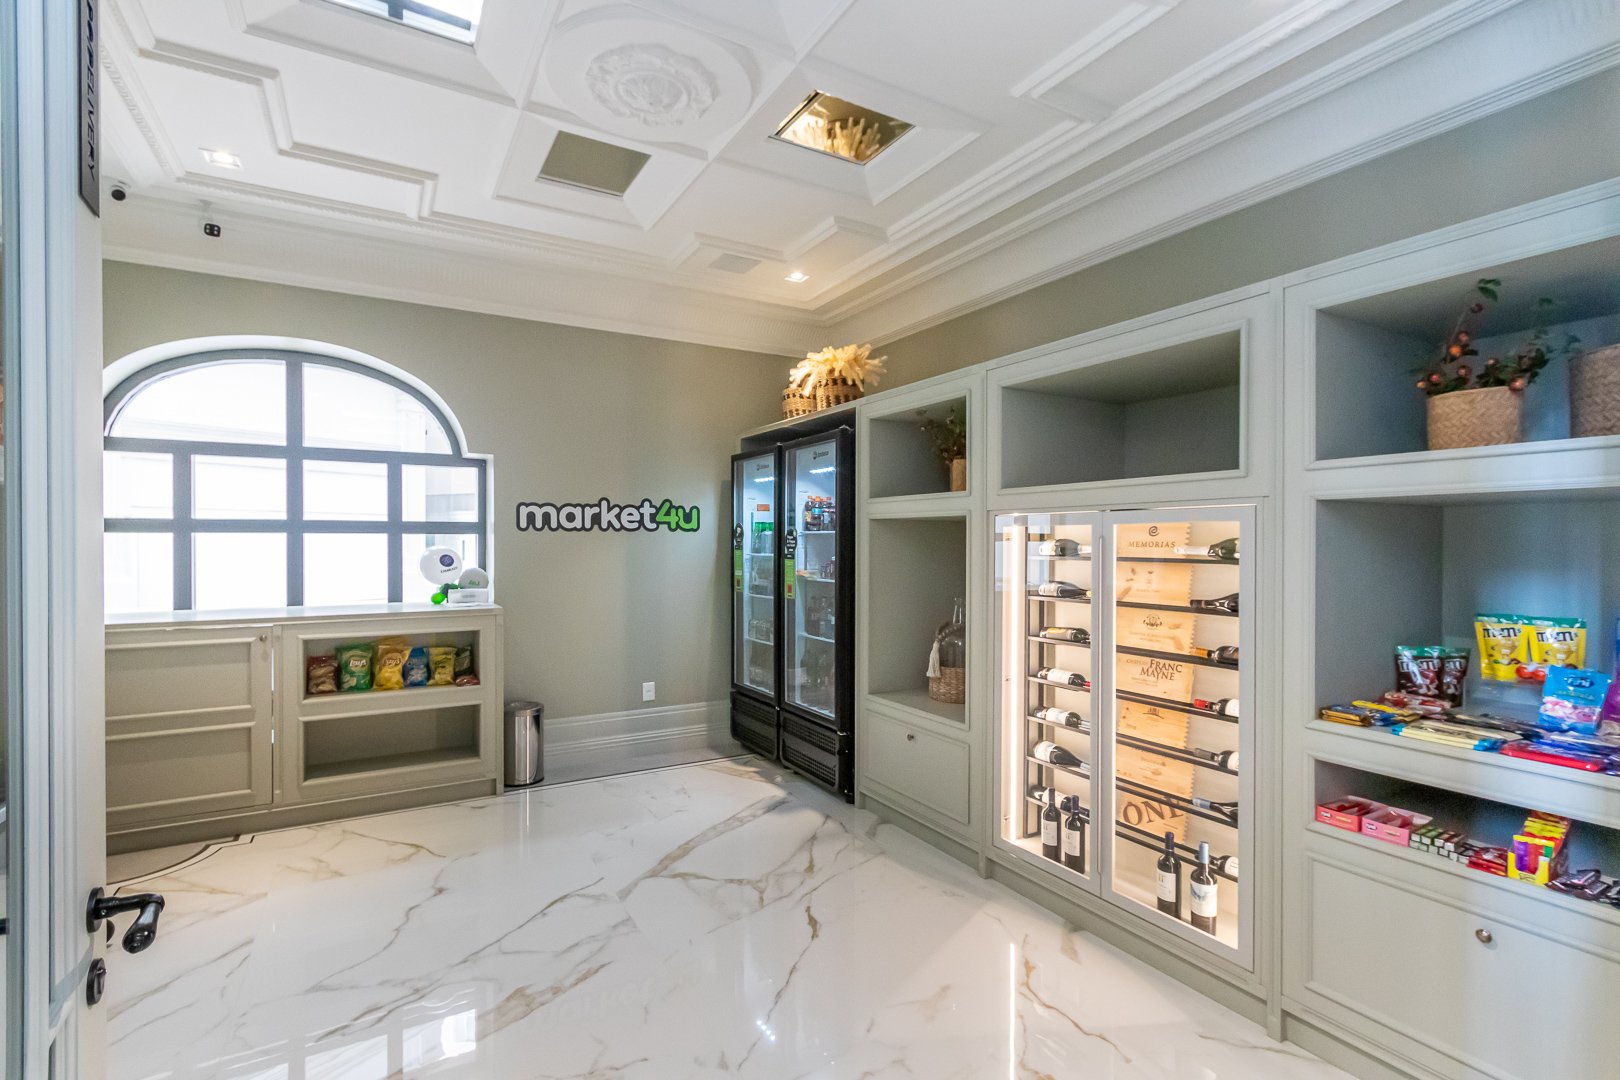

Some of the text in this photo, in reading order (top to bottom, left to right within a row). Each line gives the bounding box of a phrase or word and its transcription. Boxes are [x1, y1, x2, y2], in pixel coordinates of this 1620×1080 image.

[516, 497, 700, 532] market4u
[1128, 540, 1176, 549] MEMORIAS
[1149, 658, 1183, 673] FRANC
[1140, 666, 1175, 681] MAYNE
